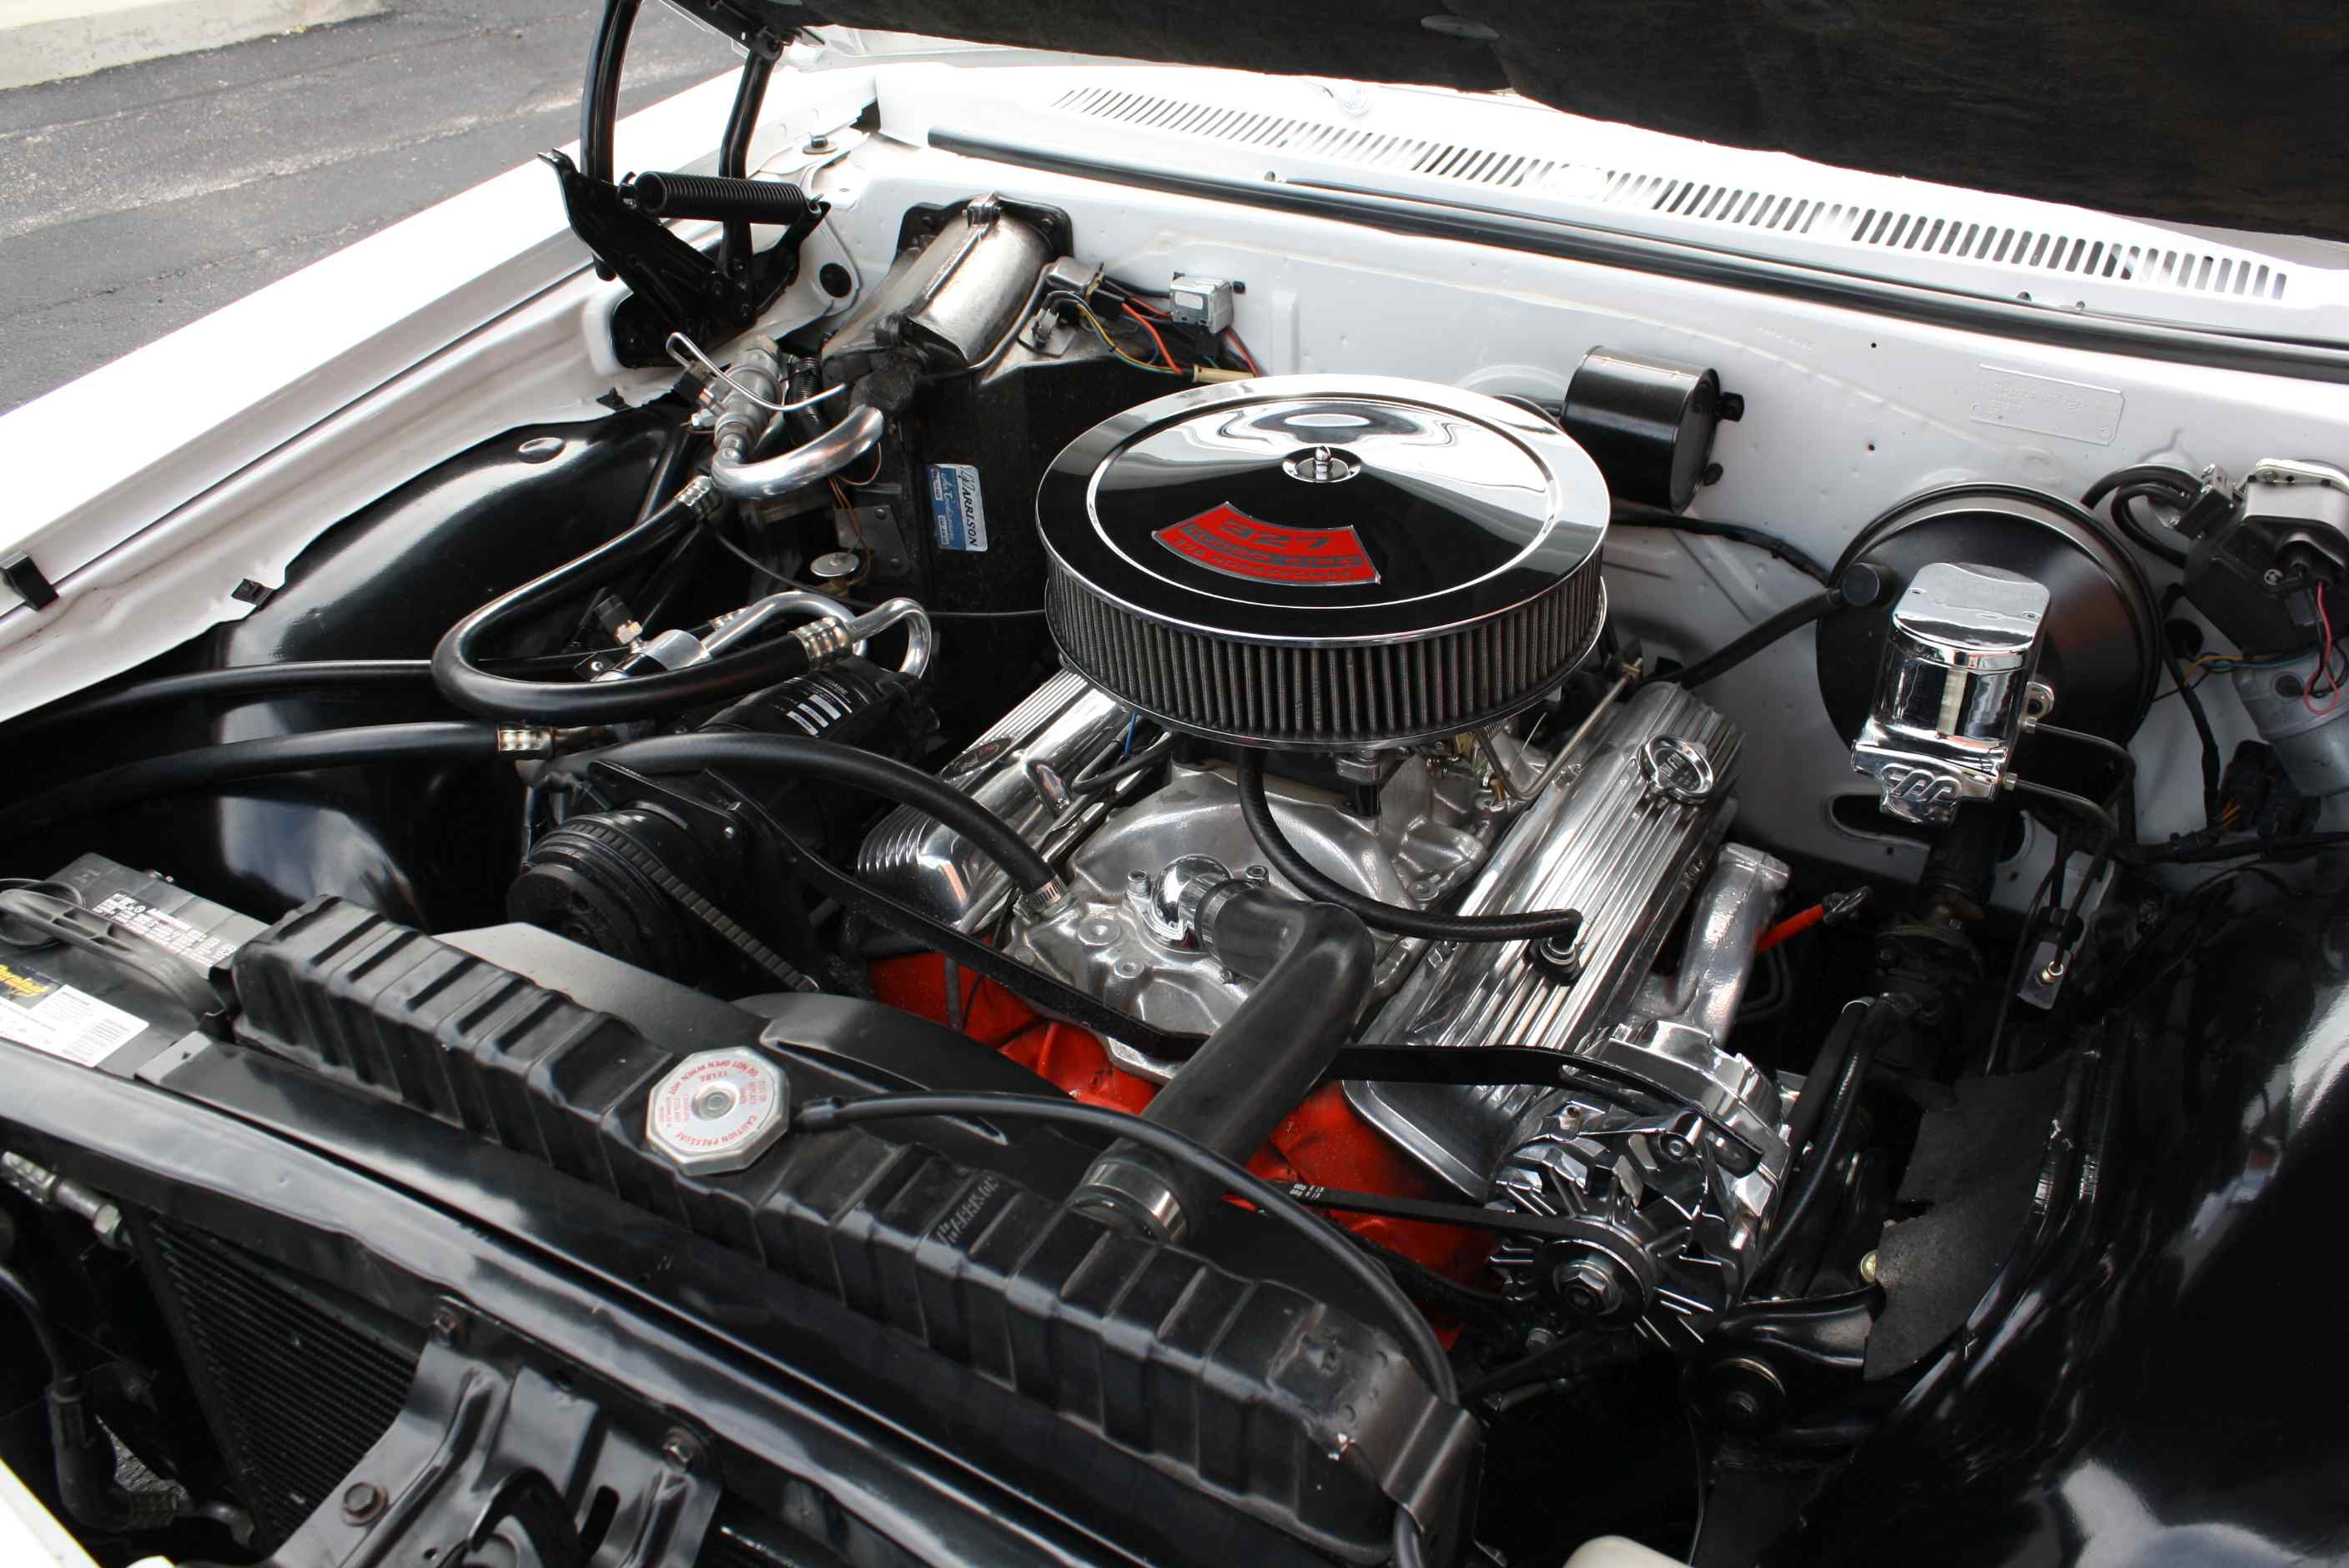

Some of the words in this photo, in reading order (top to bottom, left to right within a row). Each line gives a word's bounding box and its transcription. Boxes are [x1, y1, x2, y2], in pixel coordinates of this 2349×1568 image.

[958, 468, 978, 546] HARRISON
[1218, 520, 1330, 550] 327
[681, 1064, 707, 1081] WHEN
[707, 1060, 731, 1068] OPEN
[722, 1115, 757, 1143] CAUTION
